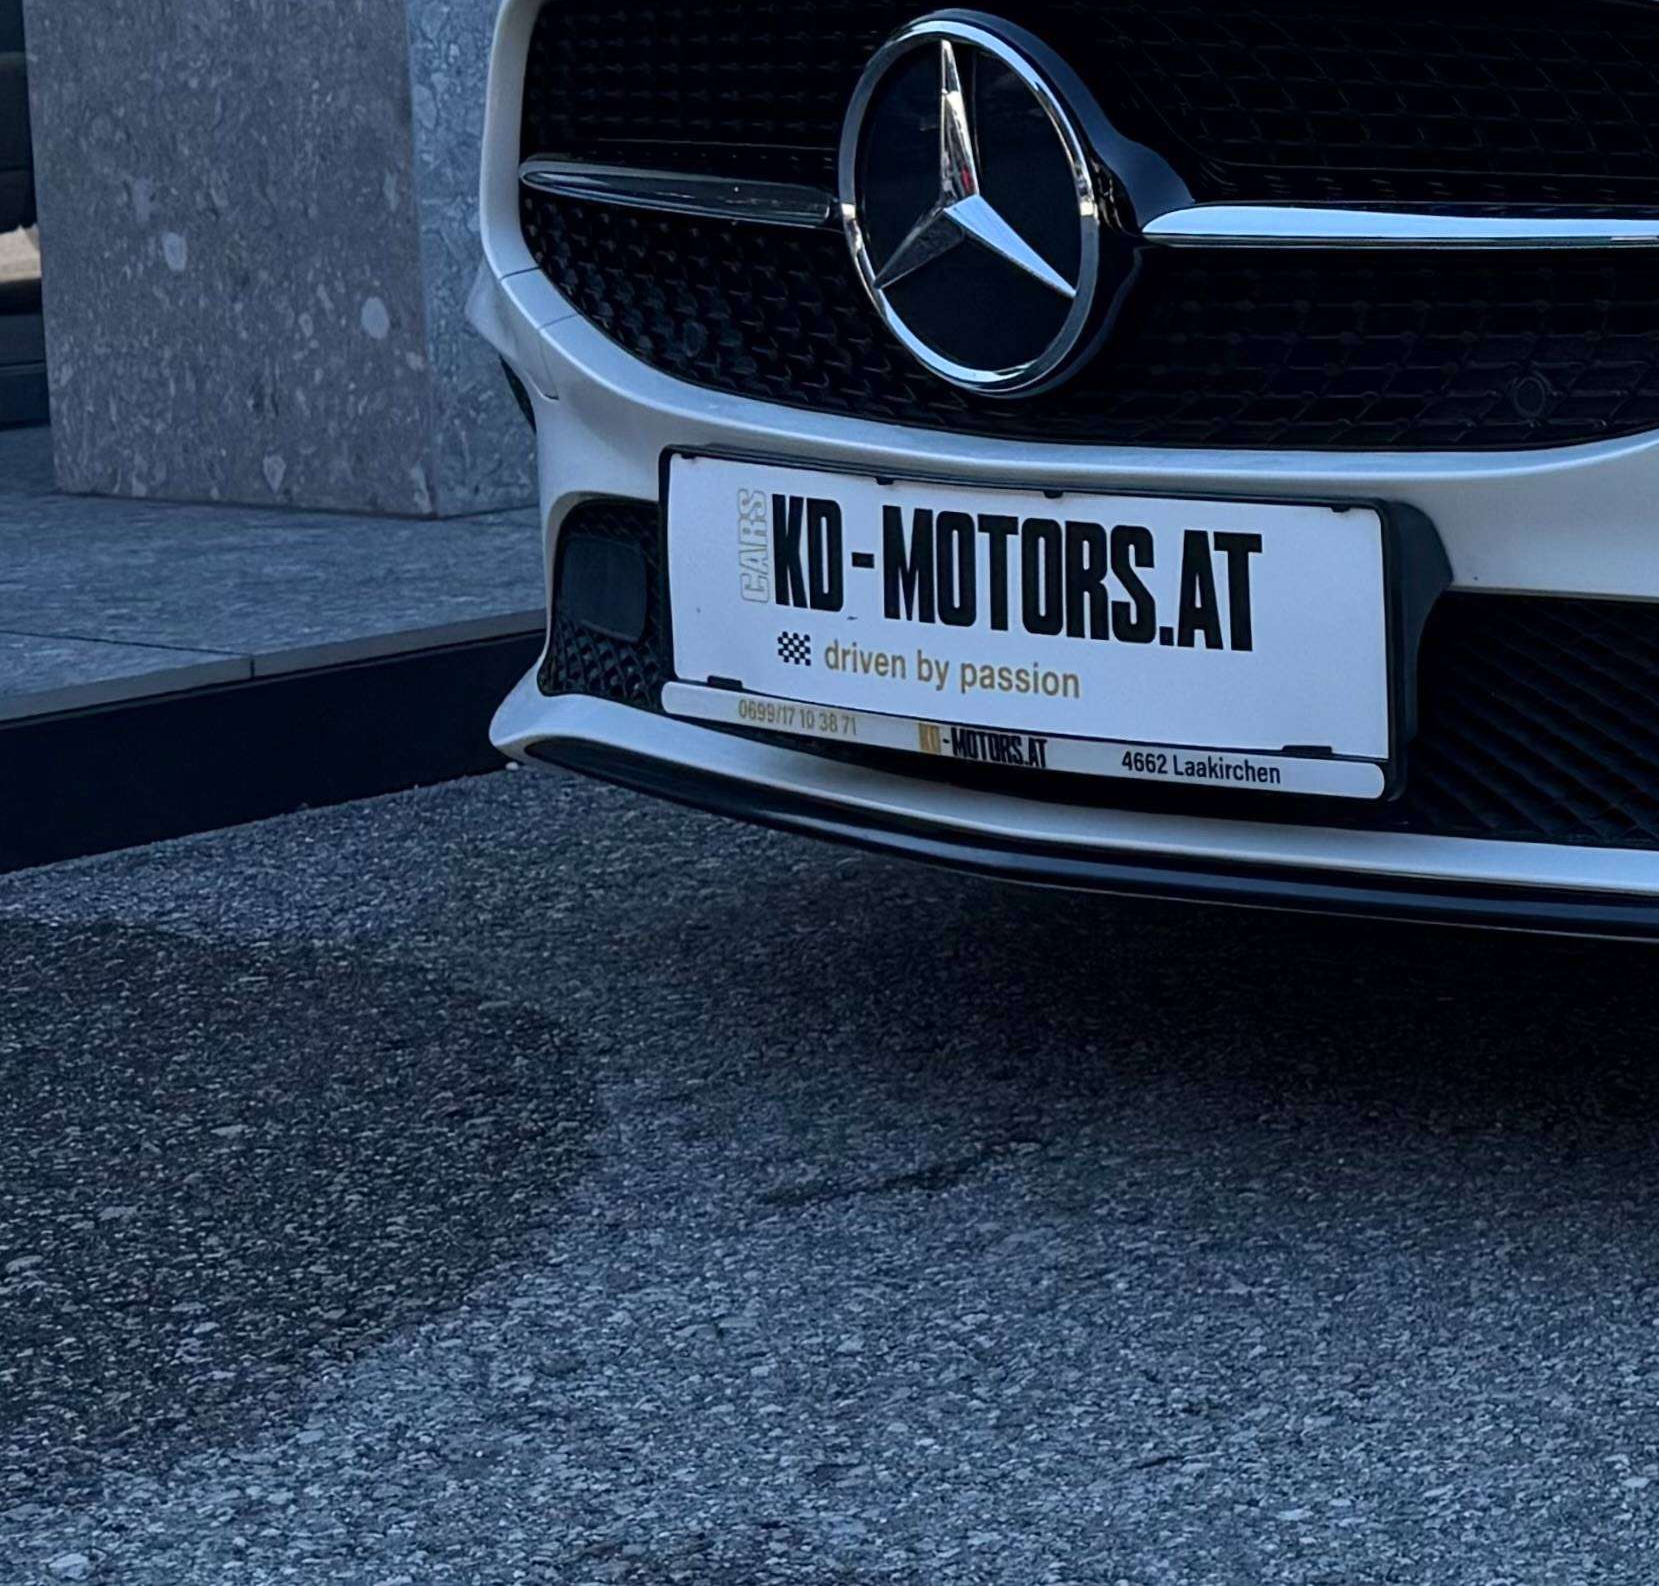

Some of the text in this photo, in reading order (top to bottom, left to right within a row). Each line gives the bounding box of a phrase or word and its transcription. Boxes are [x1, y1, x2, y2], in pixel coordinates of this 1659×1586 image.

[737, 488, 770, 603] CARS
[824, 639, 1080, 698] driven by passion
[798, 711, 815, 729] 10
[819, 715, 838, 732] 38
[1121, 750, 1281, 785] 4662 Laakirchen
